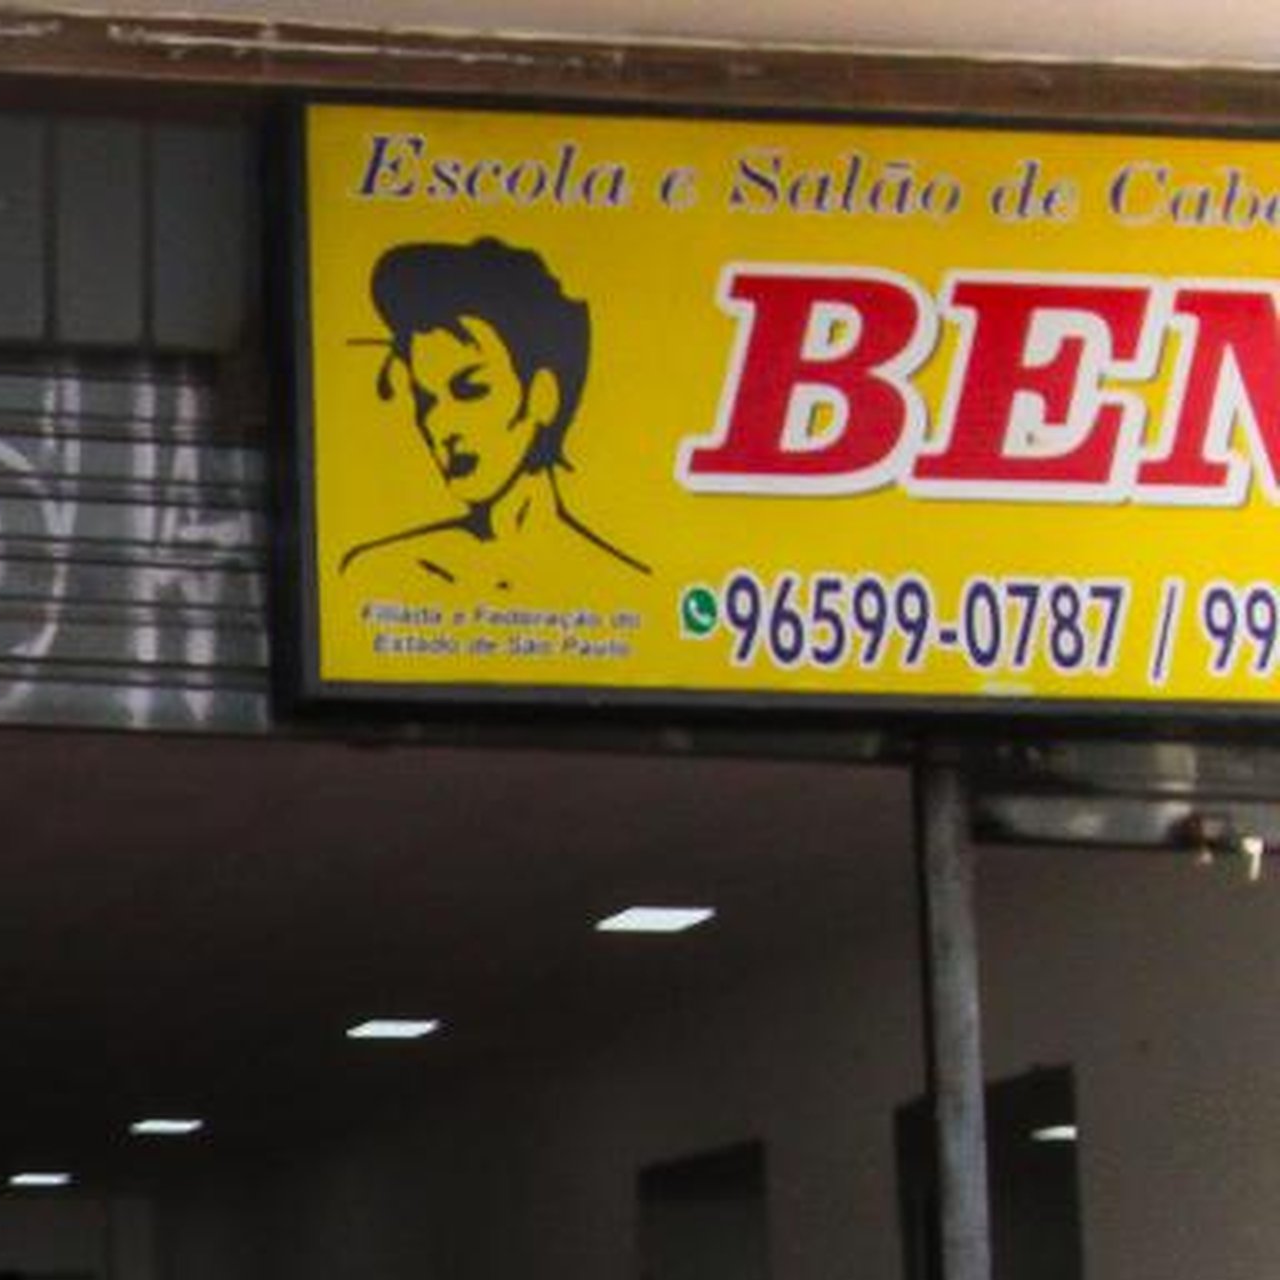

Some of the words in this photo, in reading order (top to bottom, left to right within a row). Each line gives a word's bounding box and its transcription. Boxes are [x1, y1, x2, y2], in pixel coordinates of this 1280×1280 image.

[355, 131, 633, 207] Escola
[659, 164, 700, 210] e
[725, 147, 963, 221] Salão
[990, 158, 1080, 222] de
[724, 572, 1128, 670] 96599-0787
[1149, 578, 1187, 684] /
[1200, 585, 1280, 676] 99
